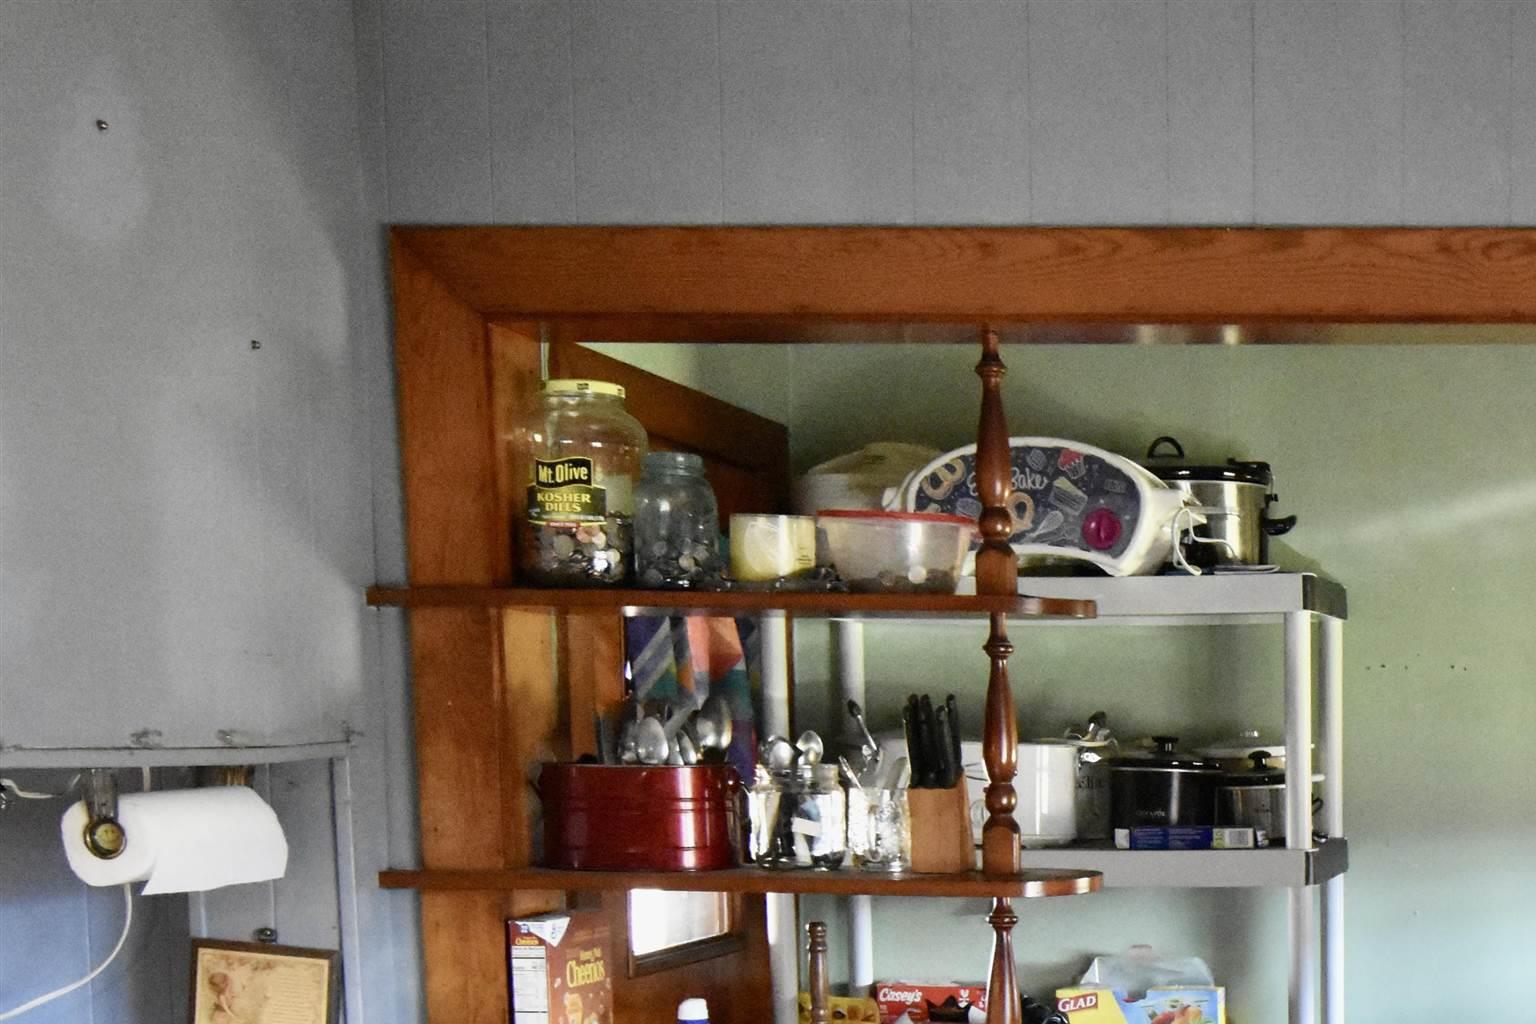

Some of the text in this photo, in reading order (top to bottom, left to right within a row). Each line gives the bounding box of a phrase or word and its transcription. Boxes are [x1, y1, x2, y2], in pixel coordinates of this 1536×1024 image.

[538, 463, 588, 484] Mt. Olive
[537, 492, 591, 503] KOSHER
[545, 503, 582, 512] DILLS
[879, 987, 923, 1005] Casey's
[1057, 995, 1097, 1013] GLAD
